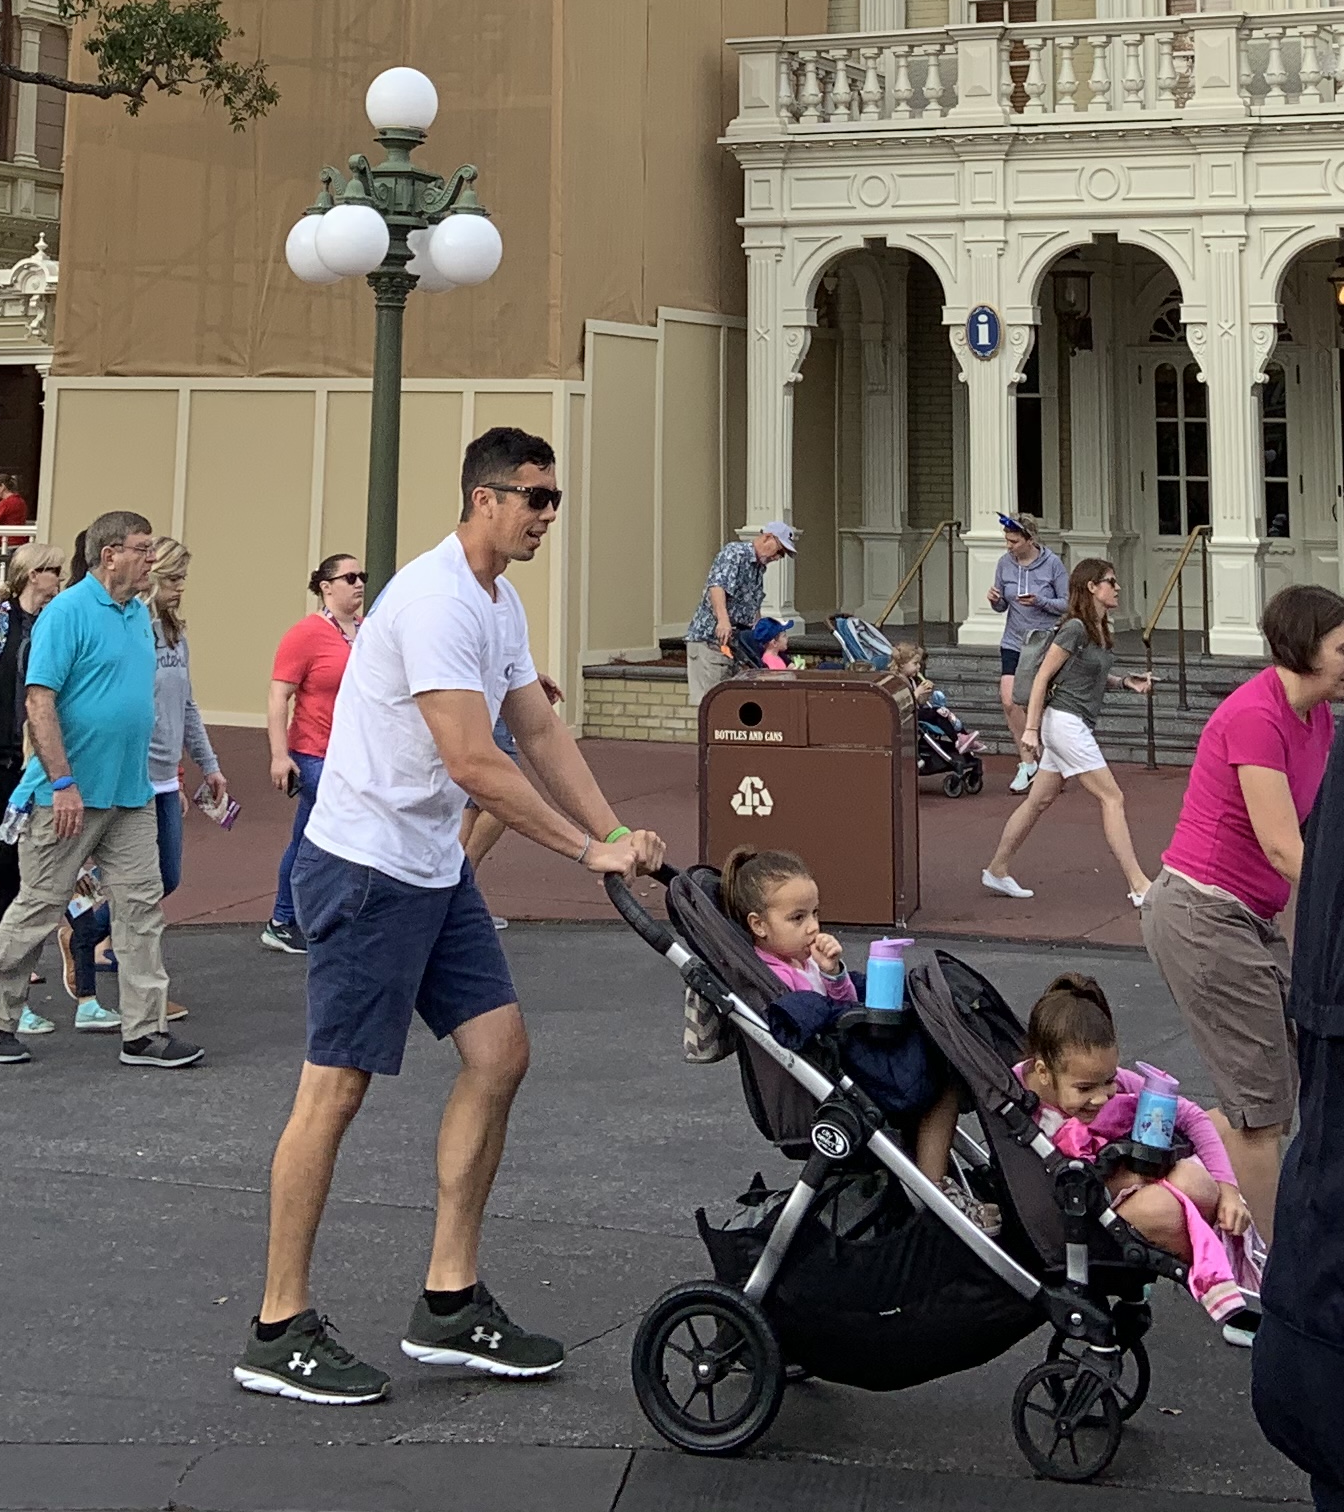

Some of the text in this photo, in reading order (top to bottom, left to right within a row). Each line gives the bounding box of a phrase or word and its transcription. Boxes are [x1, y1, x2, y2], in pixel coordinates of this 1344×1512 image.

[714, 729, 783, 742] BOTTLES AND CANS
